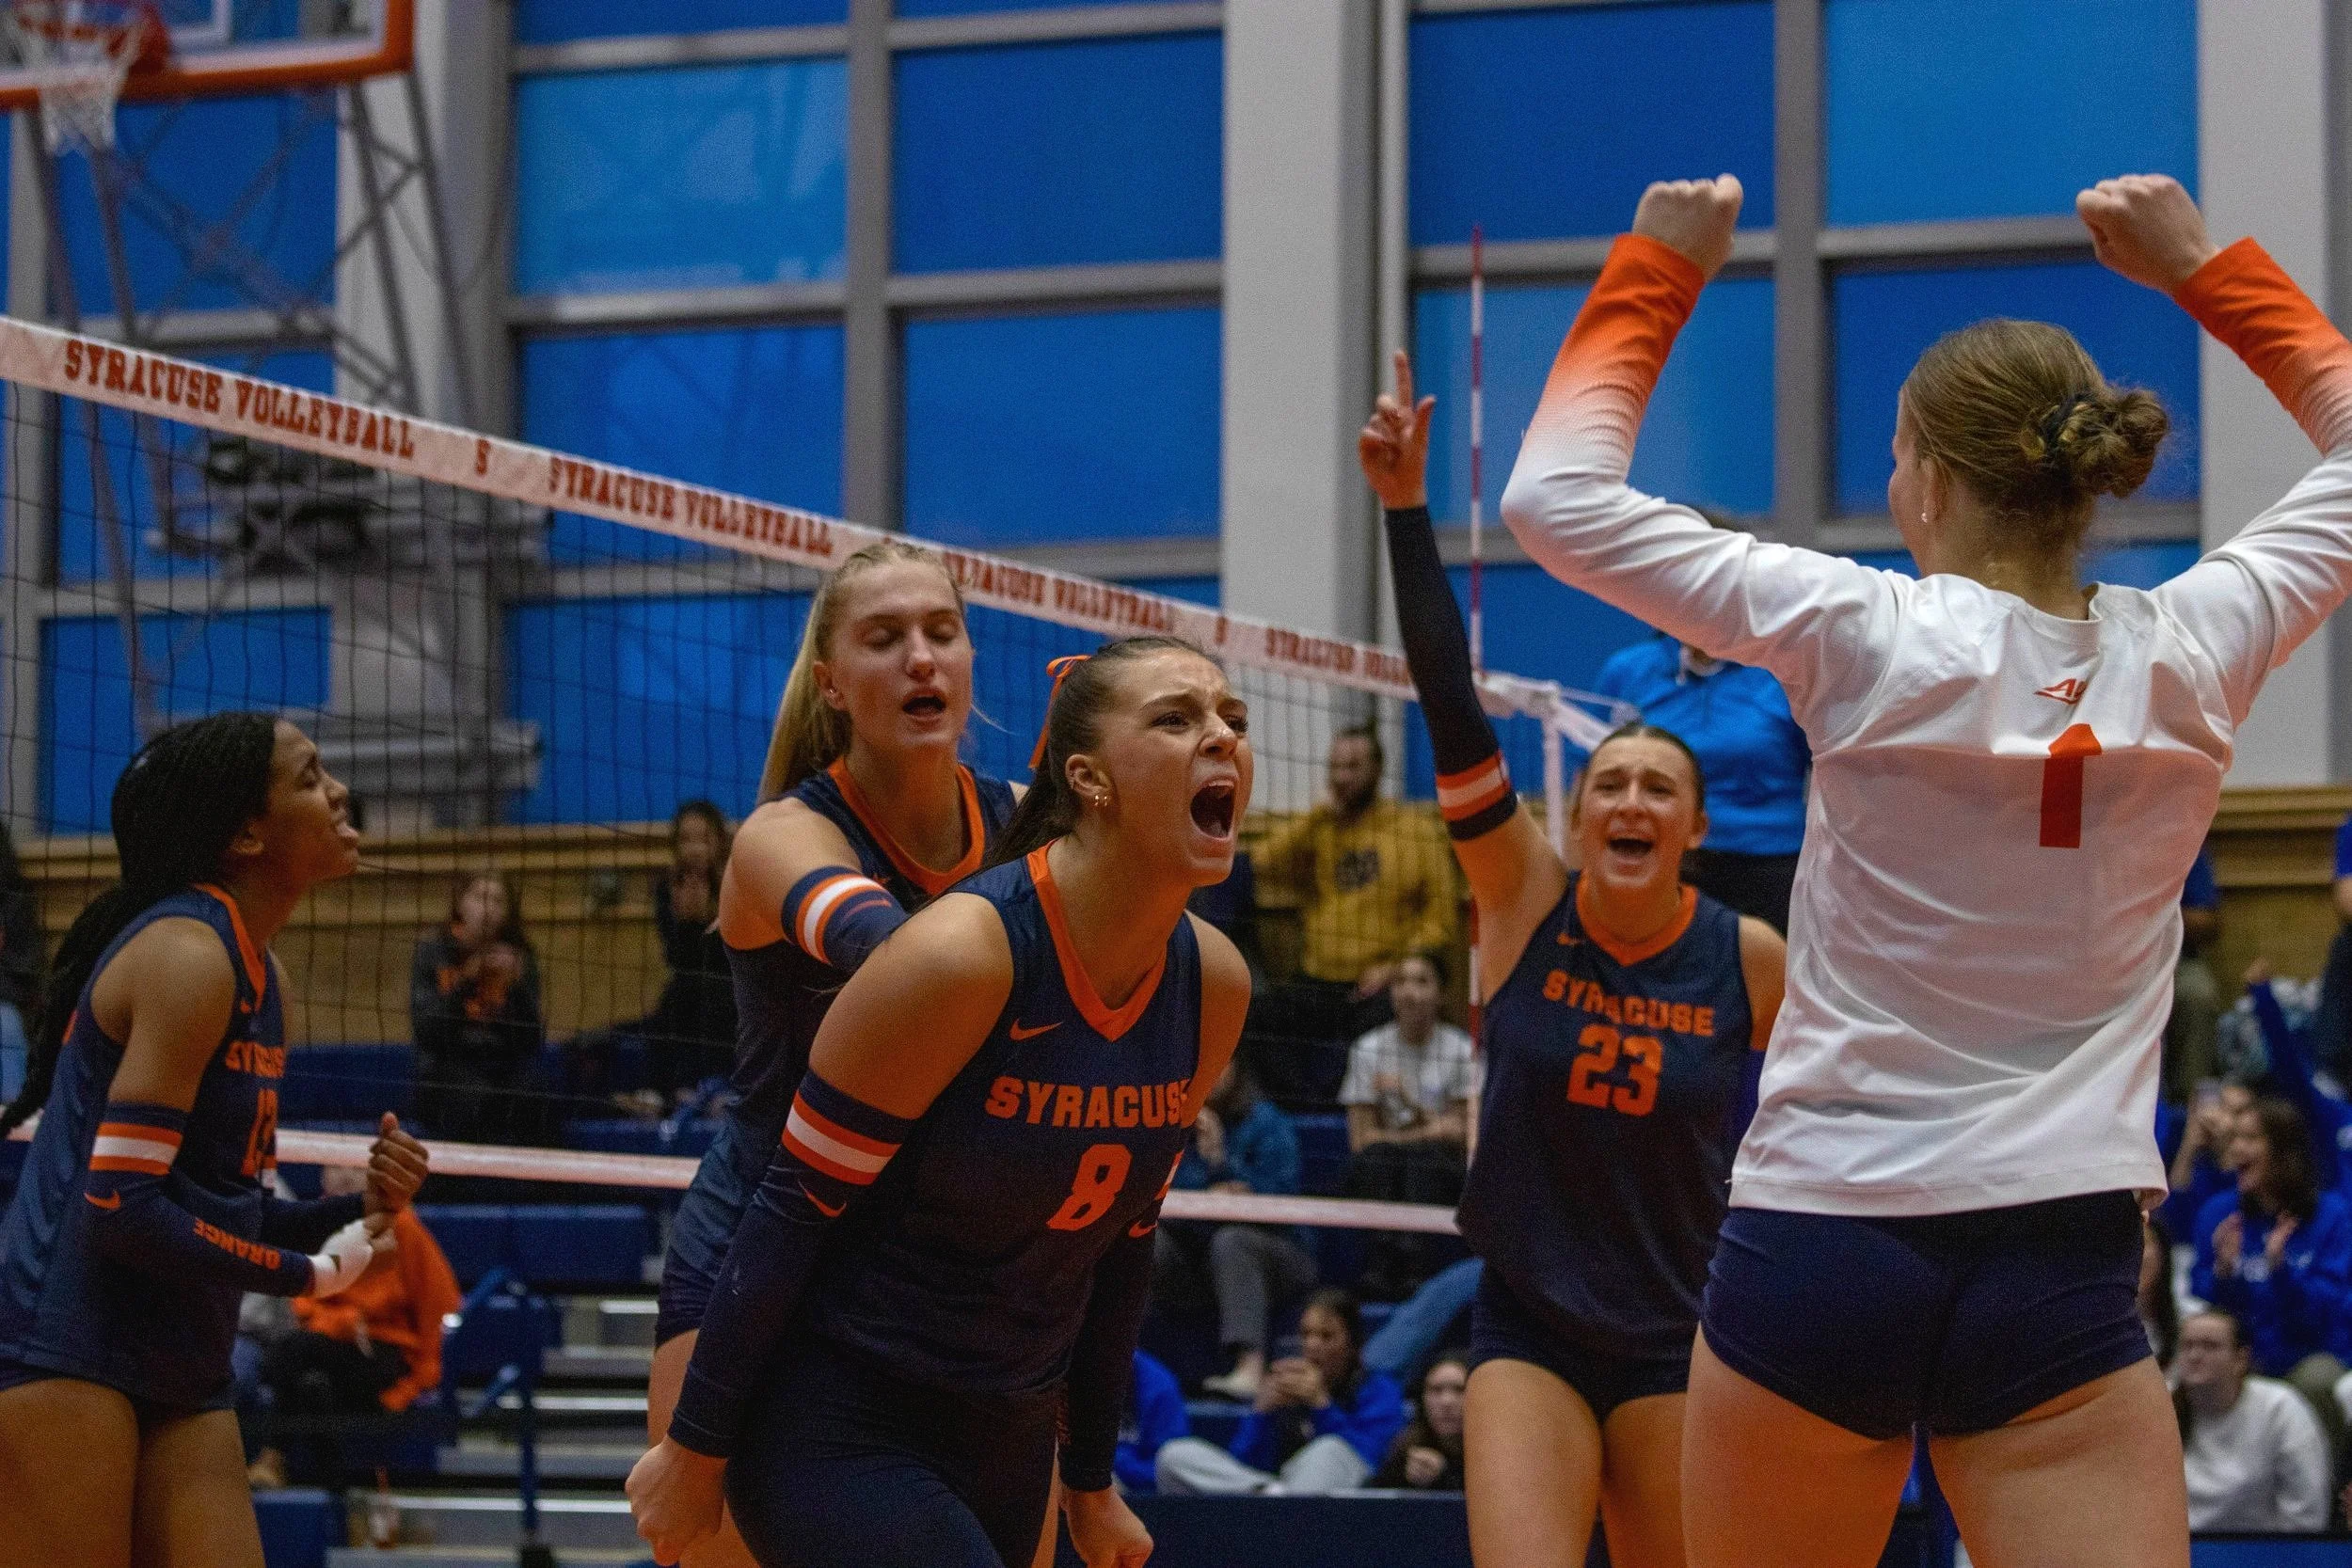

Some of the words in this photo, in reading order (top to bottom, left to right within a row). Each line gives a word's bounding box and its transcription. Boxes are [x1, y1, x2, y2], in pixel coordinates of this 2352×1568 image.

[65, 339, 223, 414] SYRACUSE
[234, 379, 415, 459] VOLLEYBALL
[475, 436, 491, 476] S
[548, 456, 675, 522] SYRACUSE
[684, 488, 833, 557] VOLLEYBALL
[2039, 722, 2103, 849] 1
[1543, 969, 1716, 1037] SYRACUSE
[985, 1075, 1190, 1129] SYRACUS
[1566, 1022, 1664, 1117] 23
[1046, 1144, 1133, 1231] 8
[193, 1217, 281, 1270] ORANGE
